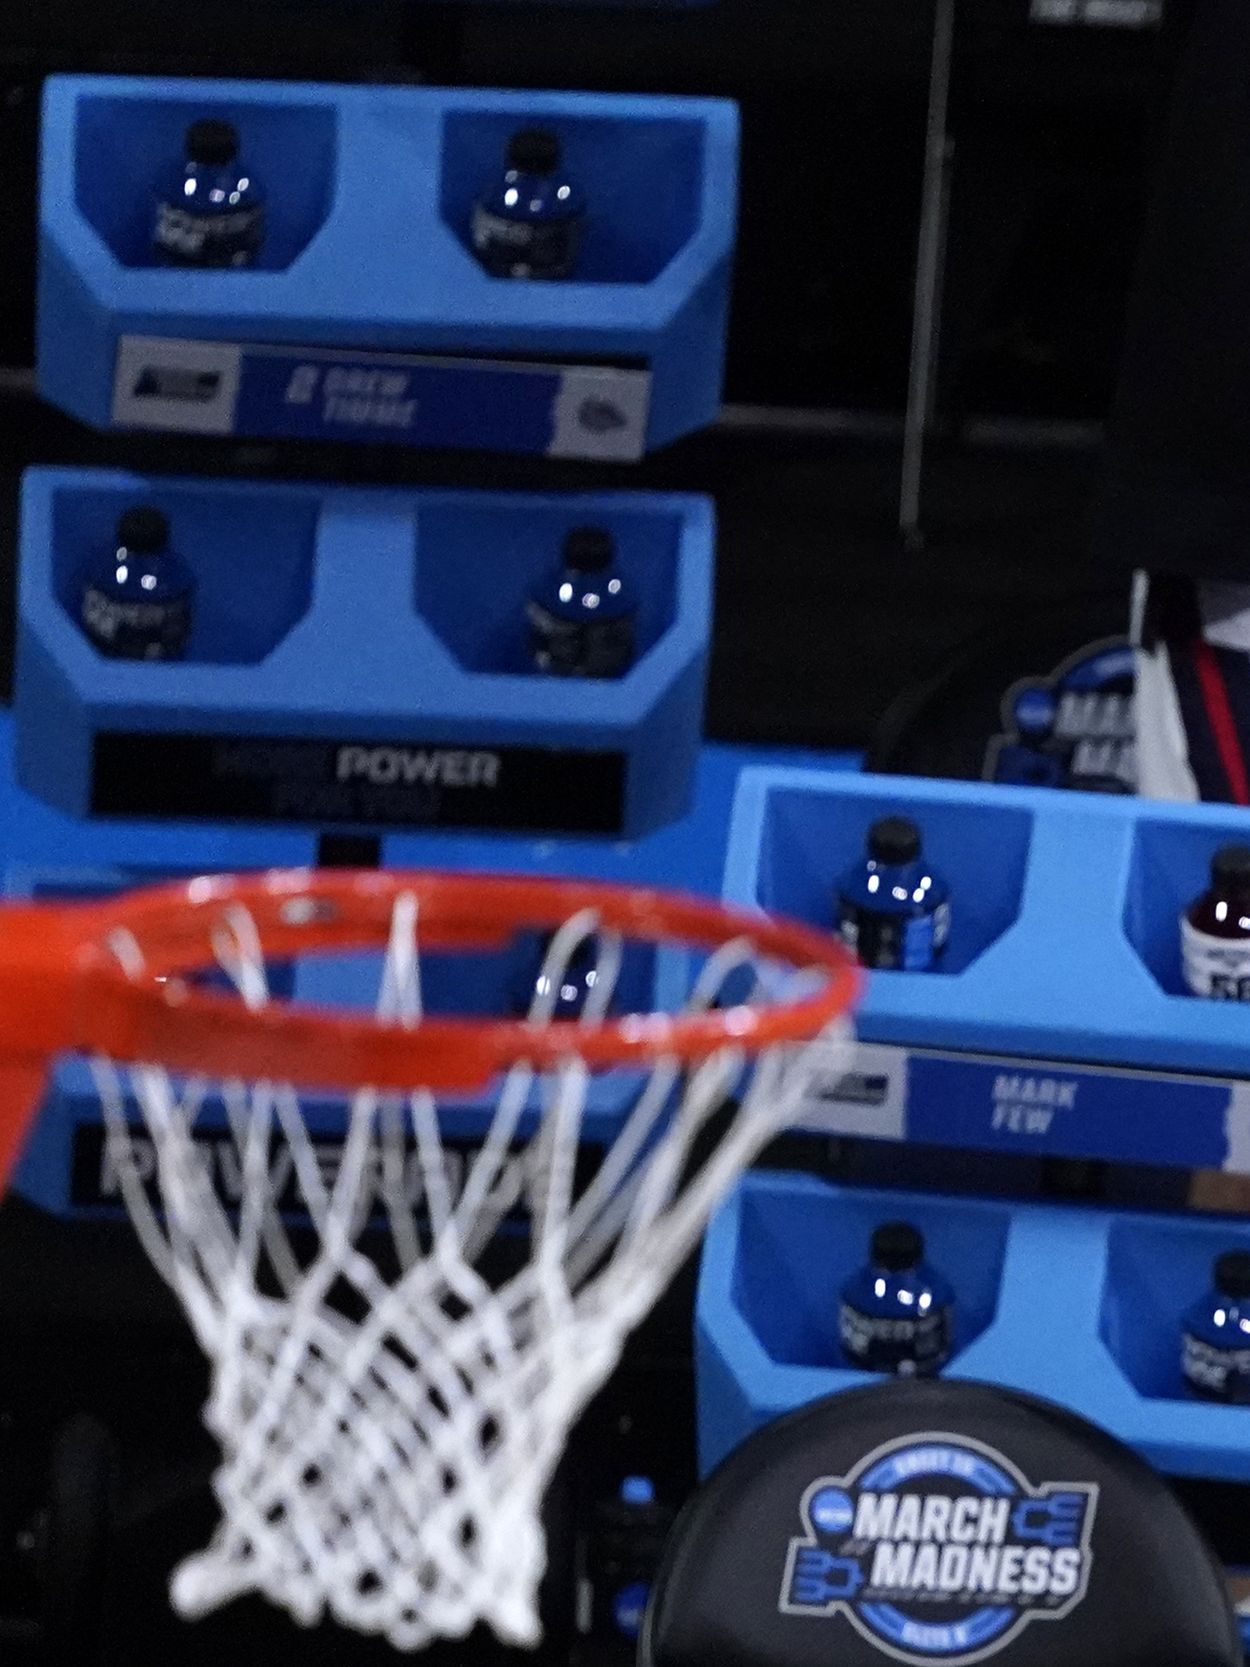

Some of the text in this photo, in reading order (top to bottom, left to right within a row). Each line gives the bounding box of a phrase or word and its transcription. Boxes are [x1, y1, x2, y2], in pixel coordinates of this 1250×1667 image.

[336, 746, 499, 788] POWER
[991, 1074, 1079, 1111] MARK
[991, 1102, 1054, 1134] FEW
[852, 1492, 1011, 1544] MARCH
[869, 1542, 1082, 1596] MADNESS
